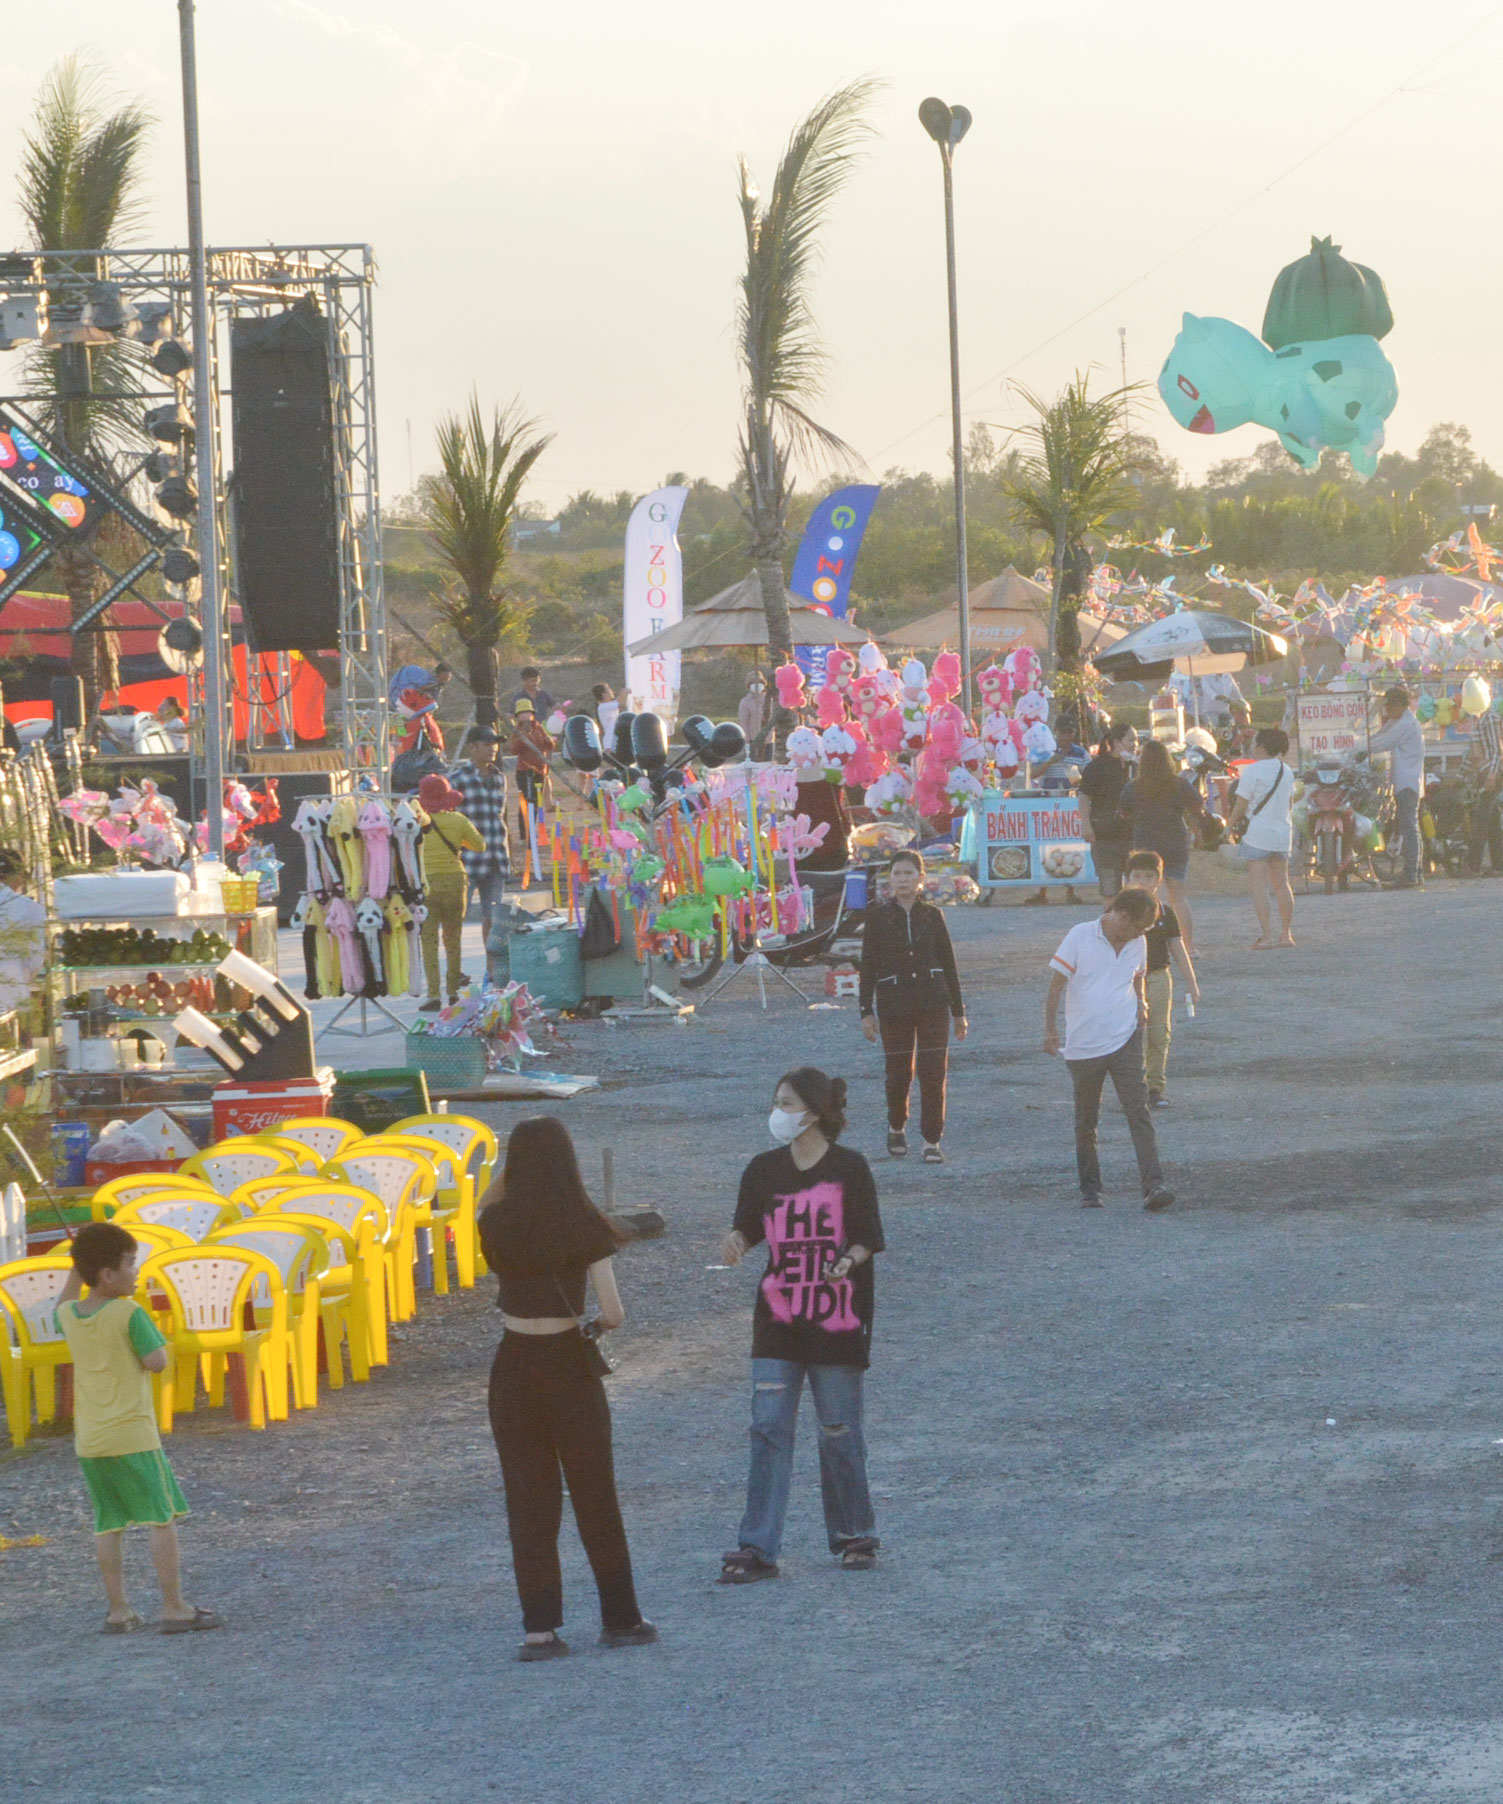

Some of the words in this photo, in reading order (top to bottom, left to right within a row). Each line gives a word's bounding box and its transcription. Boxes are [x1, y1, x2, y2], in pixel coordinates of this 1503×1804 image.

[646, 502, 668, 609] GOZOO
[987, 804, 1028, 842] BÁNH
[772, 1199, 836, 1239] THE
